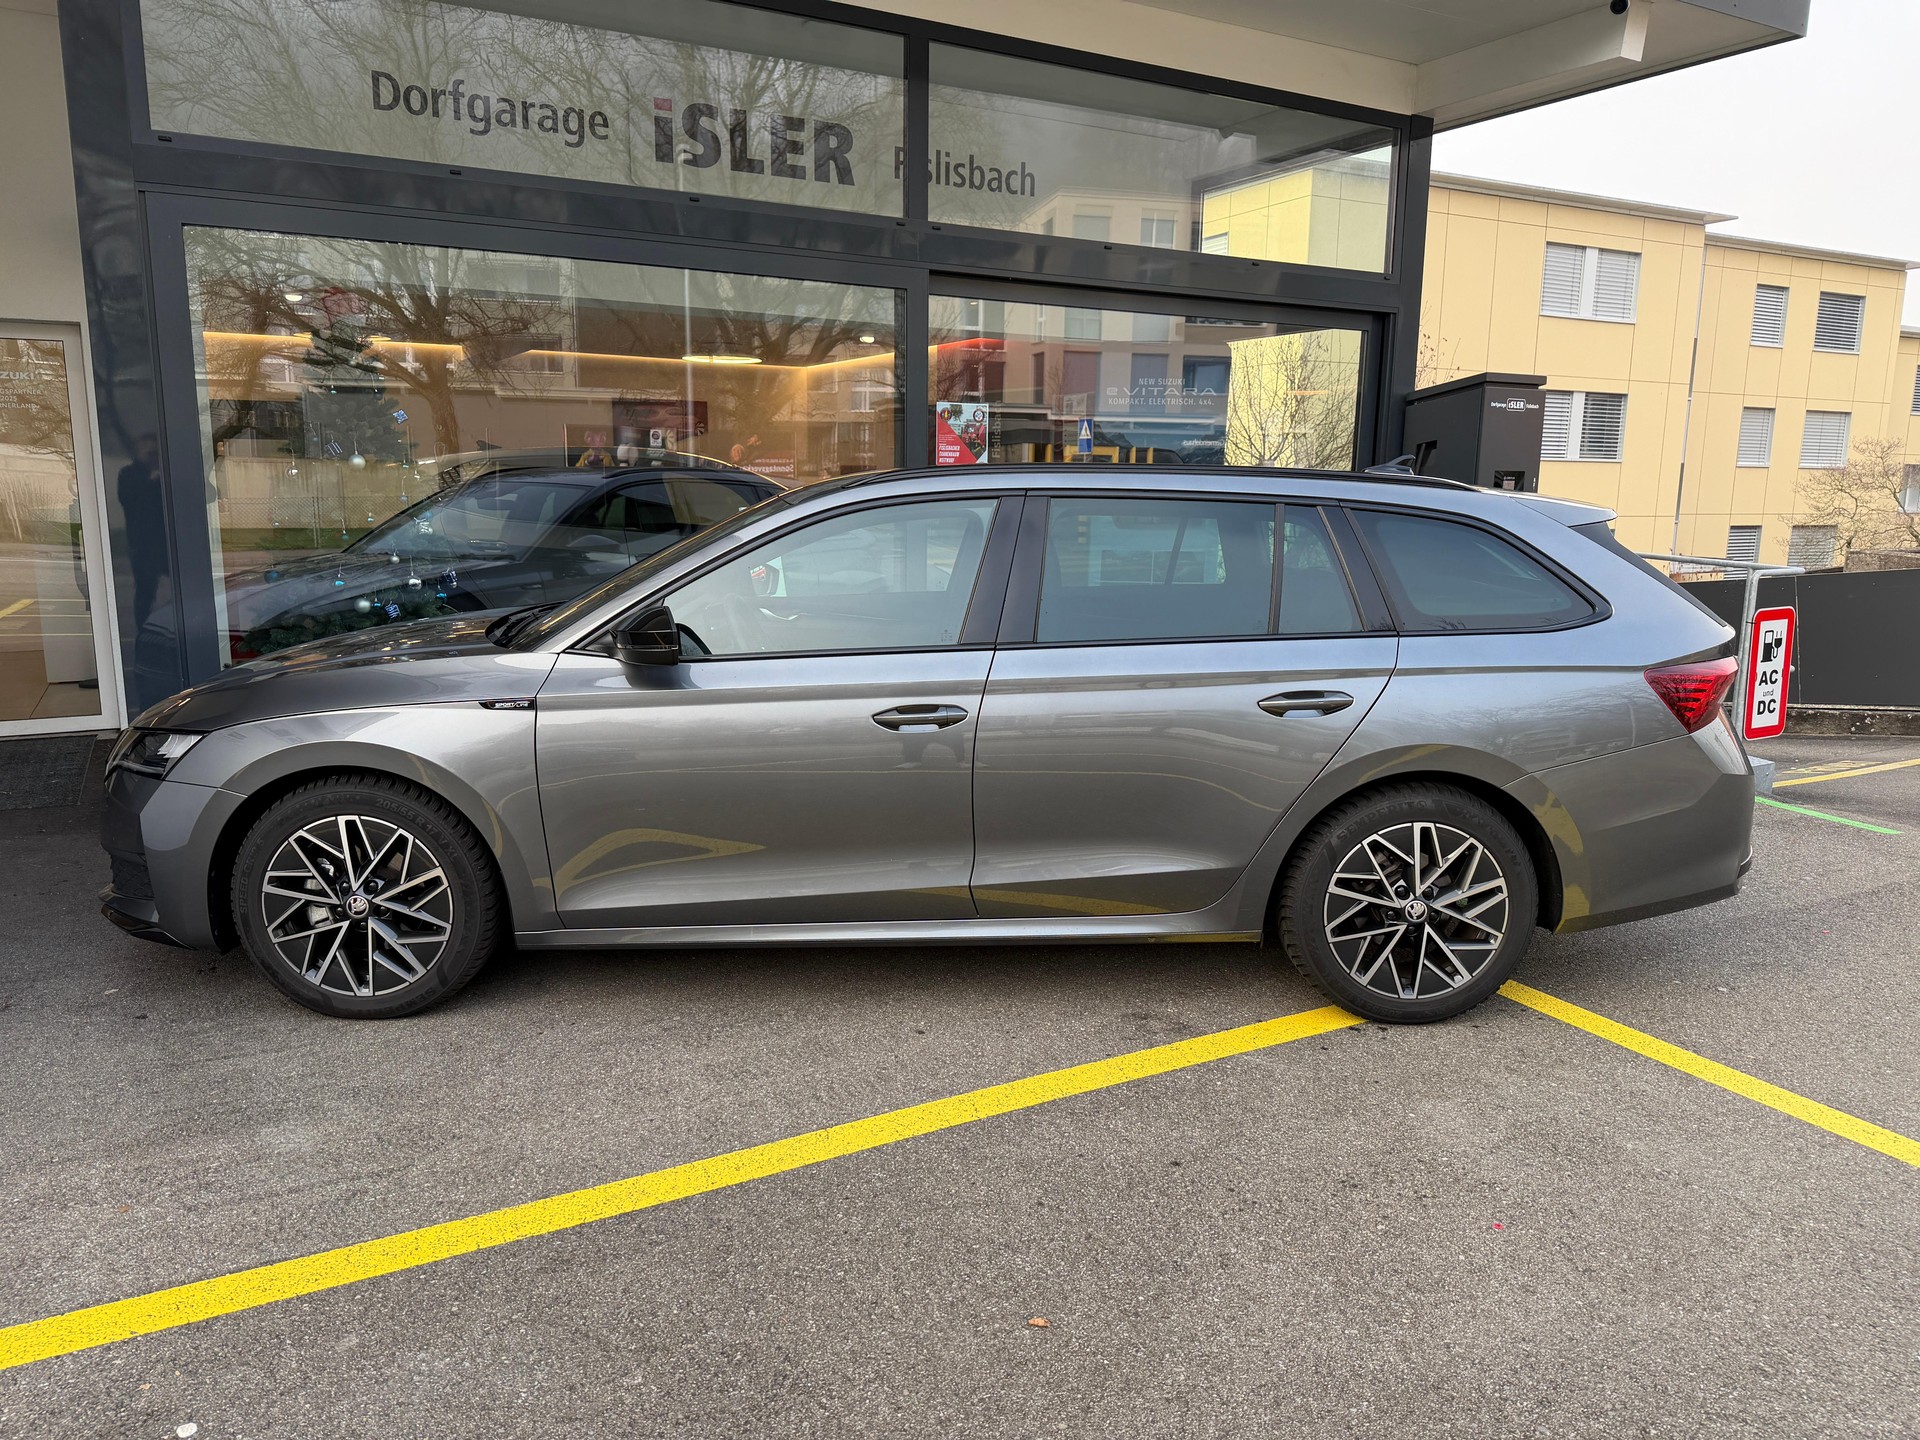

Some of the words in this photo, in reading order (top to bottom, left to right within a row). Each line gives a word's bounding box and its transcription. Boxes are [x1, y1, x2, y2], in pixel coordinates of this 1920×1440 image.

[371, 70, 609, 147] Dorfgarage
[894, 146, 1036, 197] Flisbach
[1759, 669, 1779, 686] AC
[1763, 688, 1774, 696] und
[1757, 699, 1777, 715] DC
[375, 798, 415, 820] 205/55
